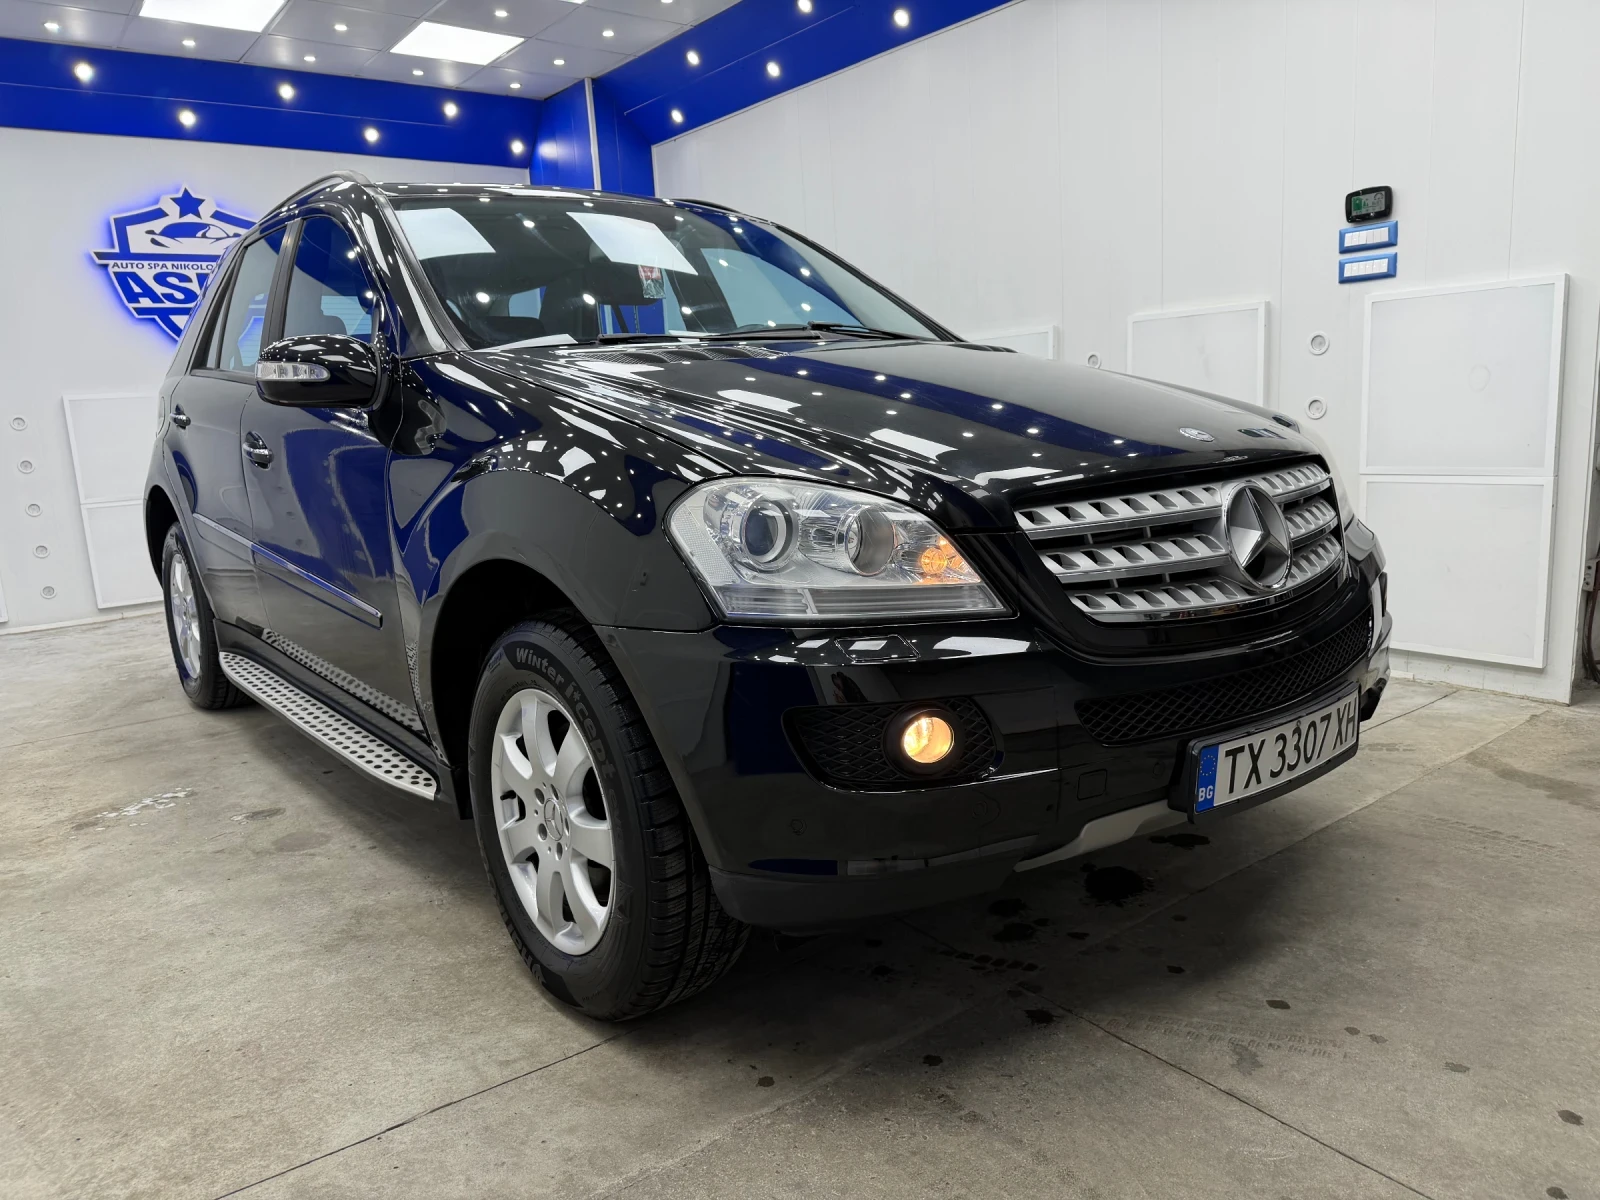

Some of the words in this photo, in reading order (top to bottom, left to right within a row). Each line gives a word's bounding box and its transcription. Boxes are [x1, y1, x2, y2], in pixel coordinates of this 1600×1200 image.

[112, 262, 145, 270] AUTO
[147, 263, 168, 271] SPA
[171, 263, 214, 271] NIKOLO
[1225, 739, 1266, 794] TX
[1269, 712, 1333, 778] 3307
[1332, 697, 1358, 750] XH
[1198, 785, 1213, 801] BG
